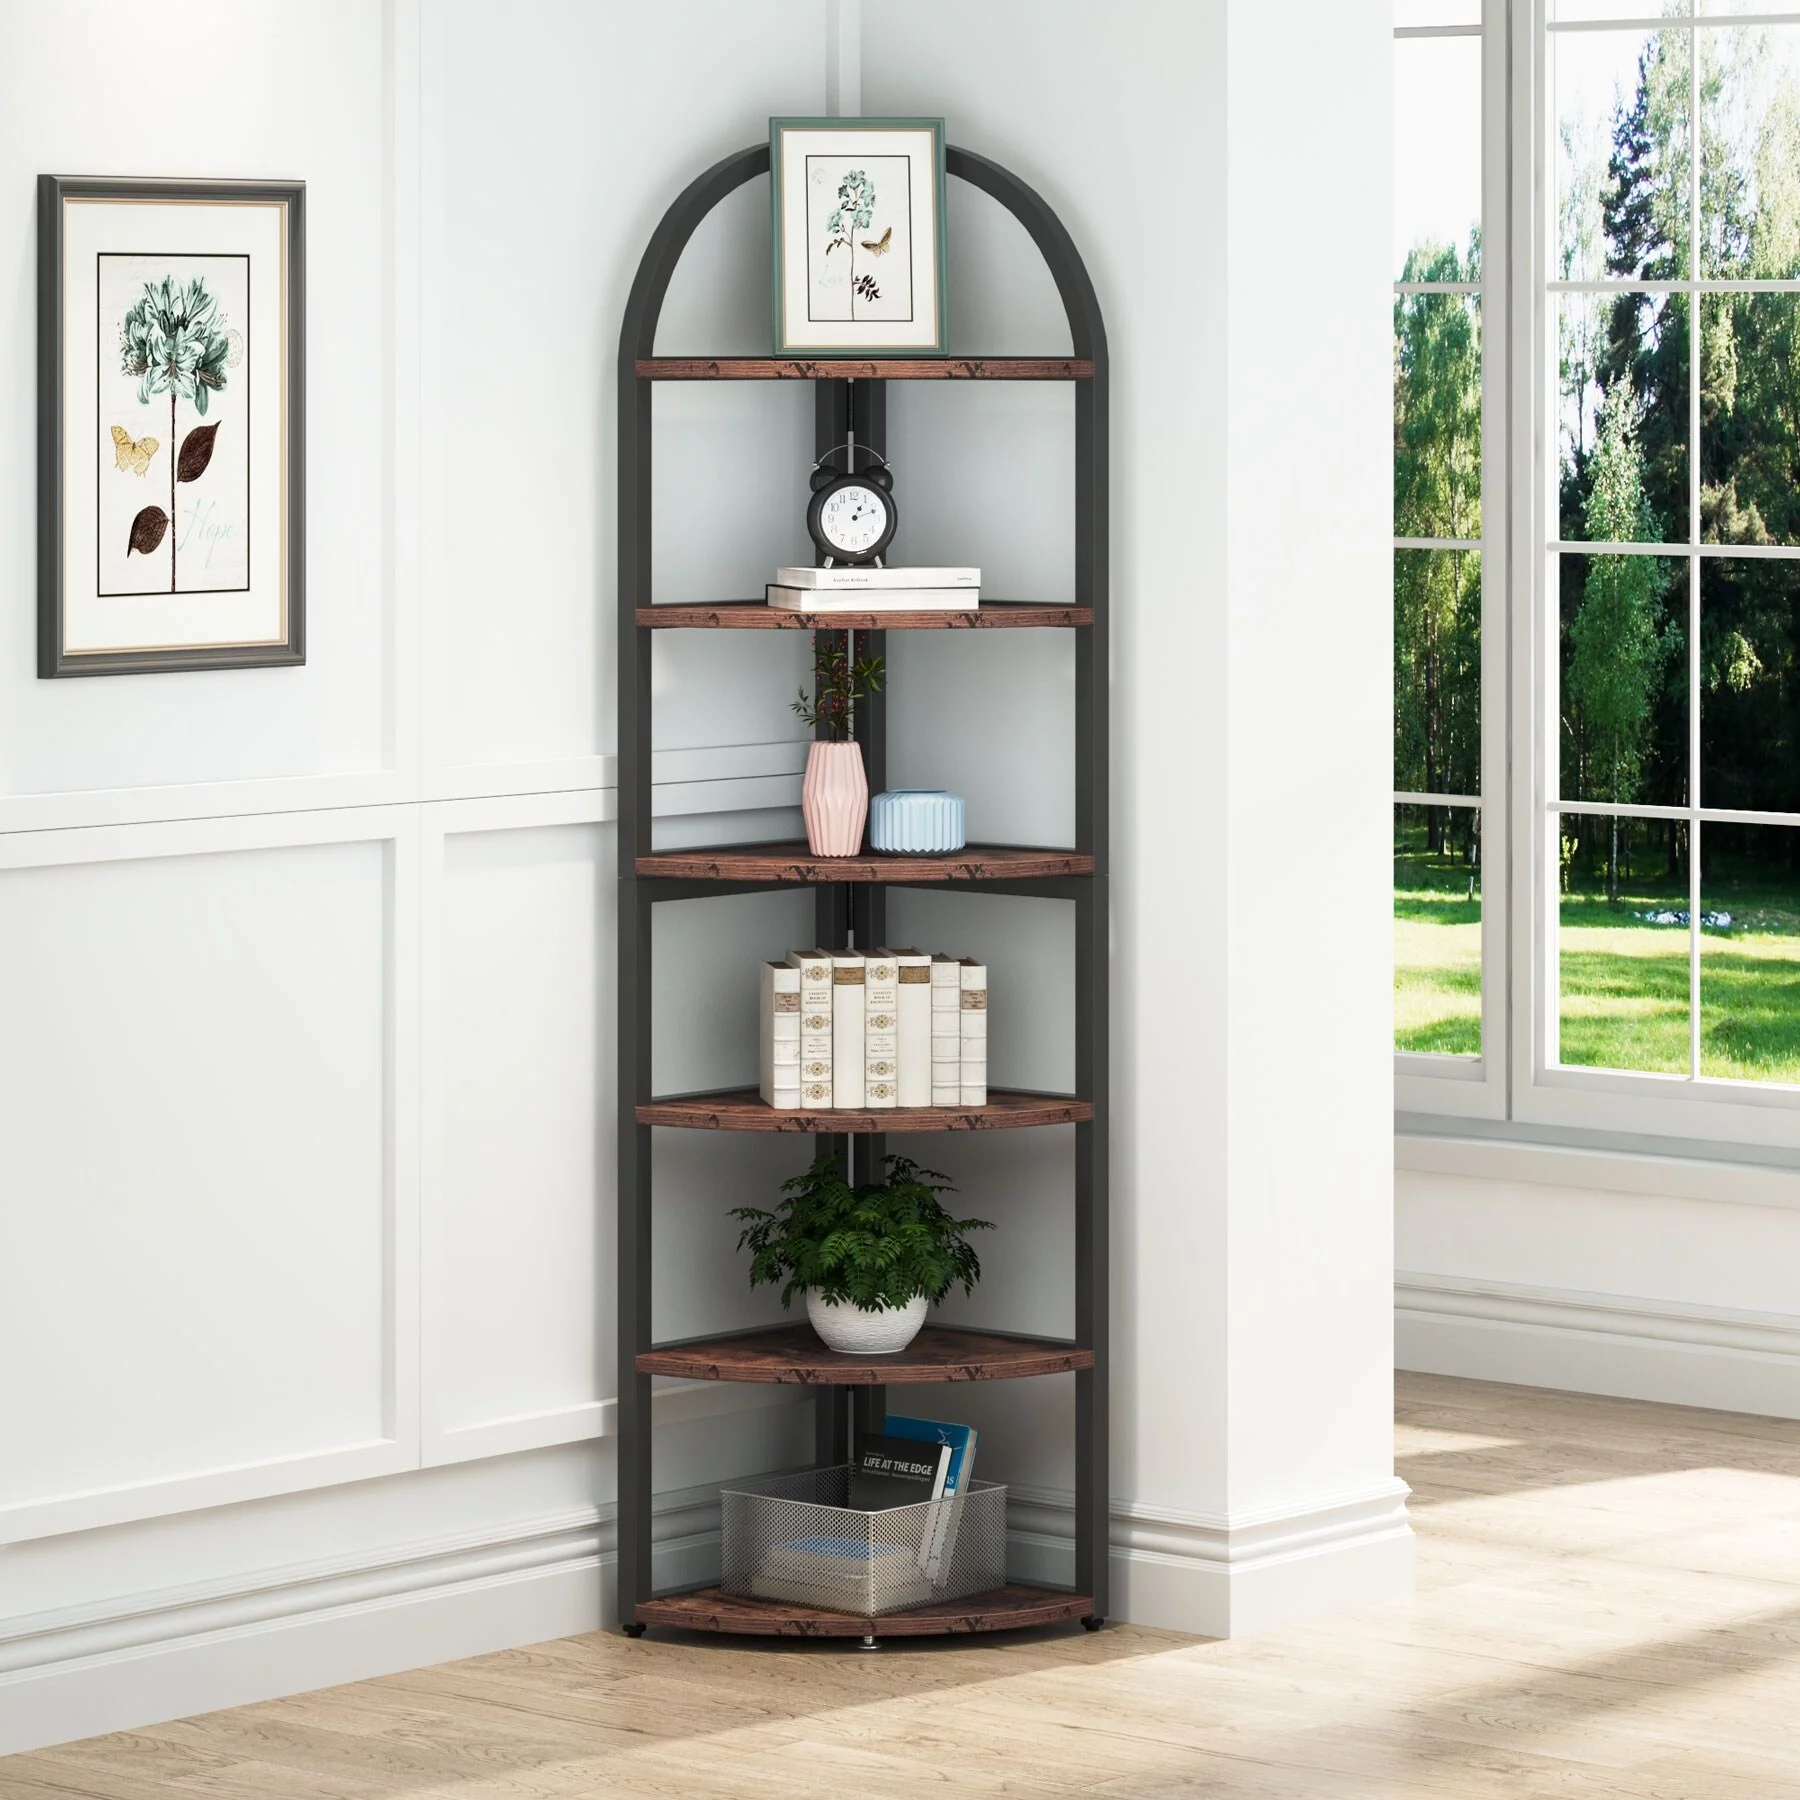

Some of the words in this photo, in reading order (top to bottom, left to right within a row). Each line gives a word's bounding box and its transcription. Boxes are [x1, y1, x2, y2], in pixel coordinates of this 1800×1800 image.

[839, 494, 846, 504] 11
[849, 491, 859, 501] 12
[830, 502, 840, 512] 10
[827, 513, 835, 524] 9
[177, 498, 235, 569] Hope
[830, 525, 838, 533] 8
[868, 525, 875, 534] 4
[840, 533, 846, 543] 7
[851, 536, 857, 545] 6
[863, 533, 869, 543] 5
[863, 1456, 881, 1468] LIFE
[881, 1459, 893, 1470] AT
[893, 1461, 910, 1472] THE
[910, 1463, 933, 1476] EDGE
